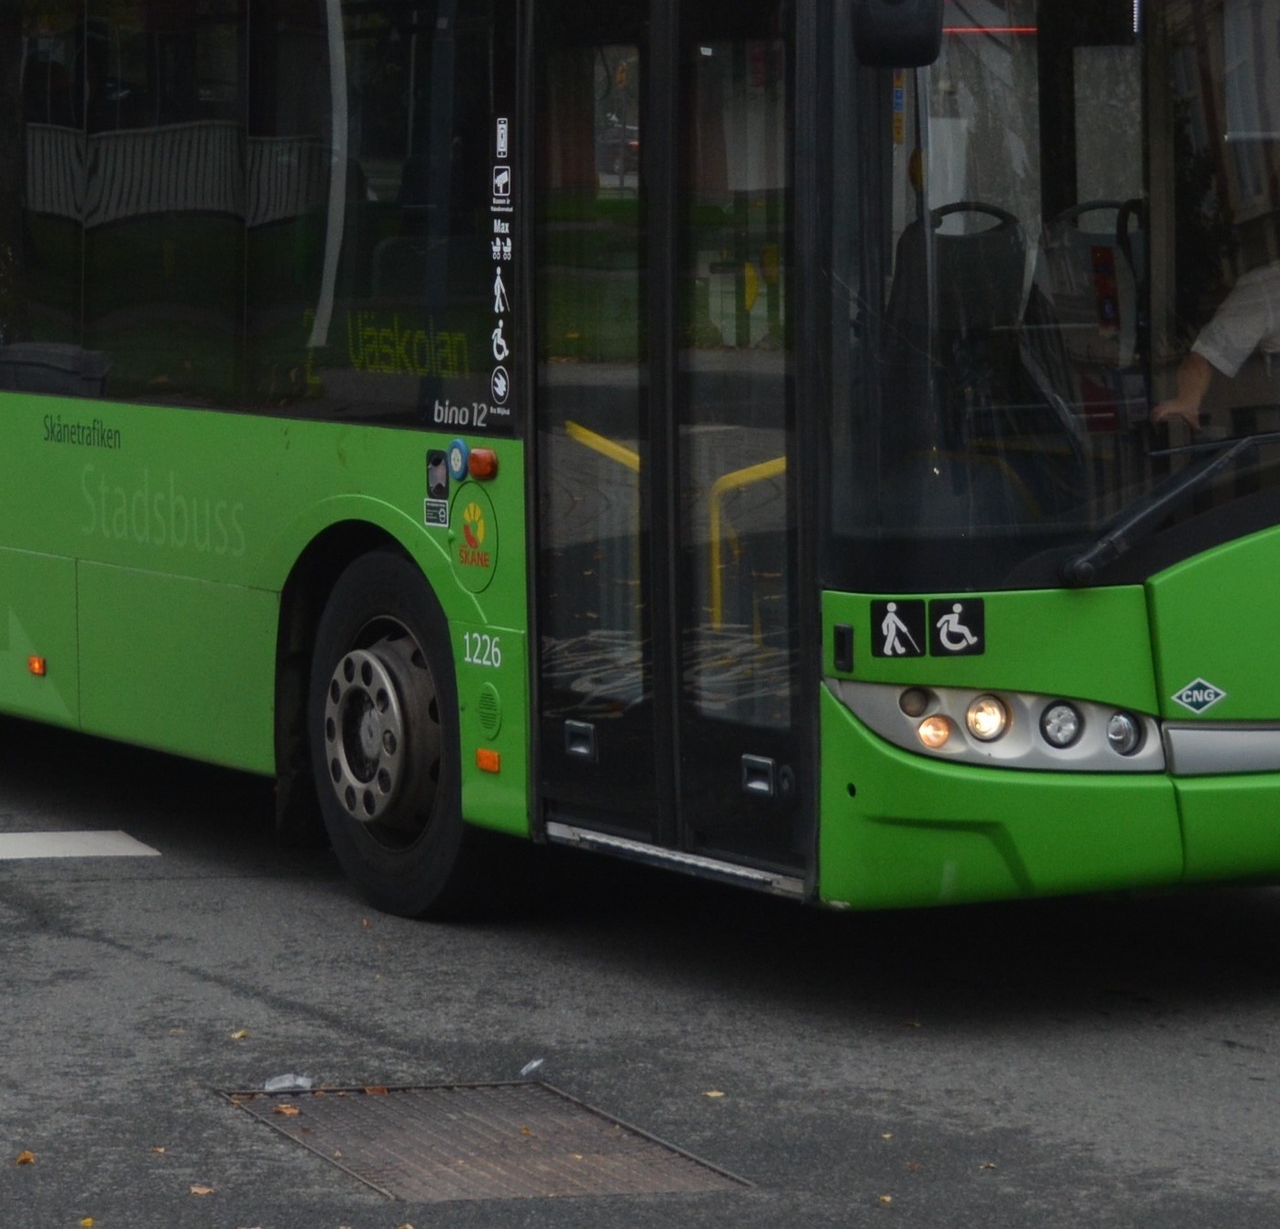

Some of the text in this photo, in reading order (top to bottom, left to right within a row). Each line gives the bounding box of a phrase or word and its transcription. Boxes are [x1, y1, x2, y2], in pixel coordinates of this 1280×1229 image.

[493, 218, 510, 234] Max
[433, 399, 470, 425] bino
[472, 402, 488, 427] 12
[43, 414, 121, 449] Skånetrafiken
[80, 463, 246, 558] Stadsbuss
[463, 631, 501, 668] 1226
[1181, 687, 1216, 705] CNG
